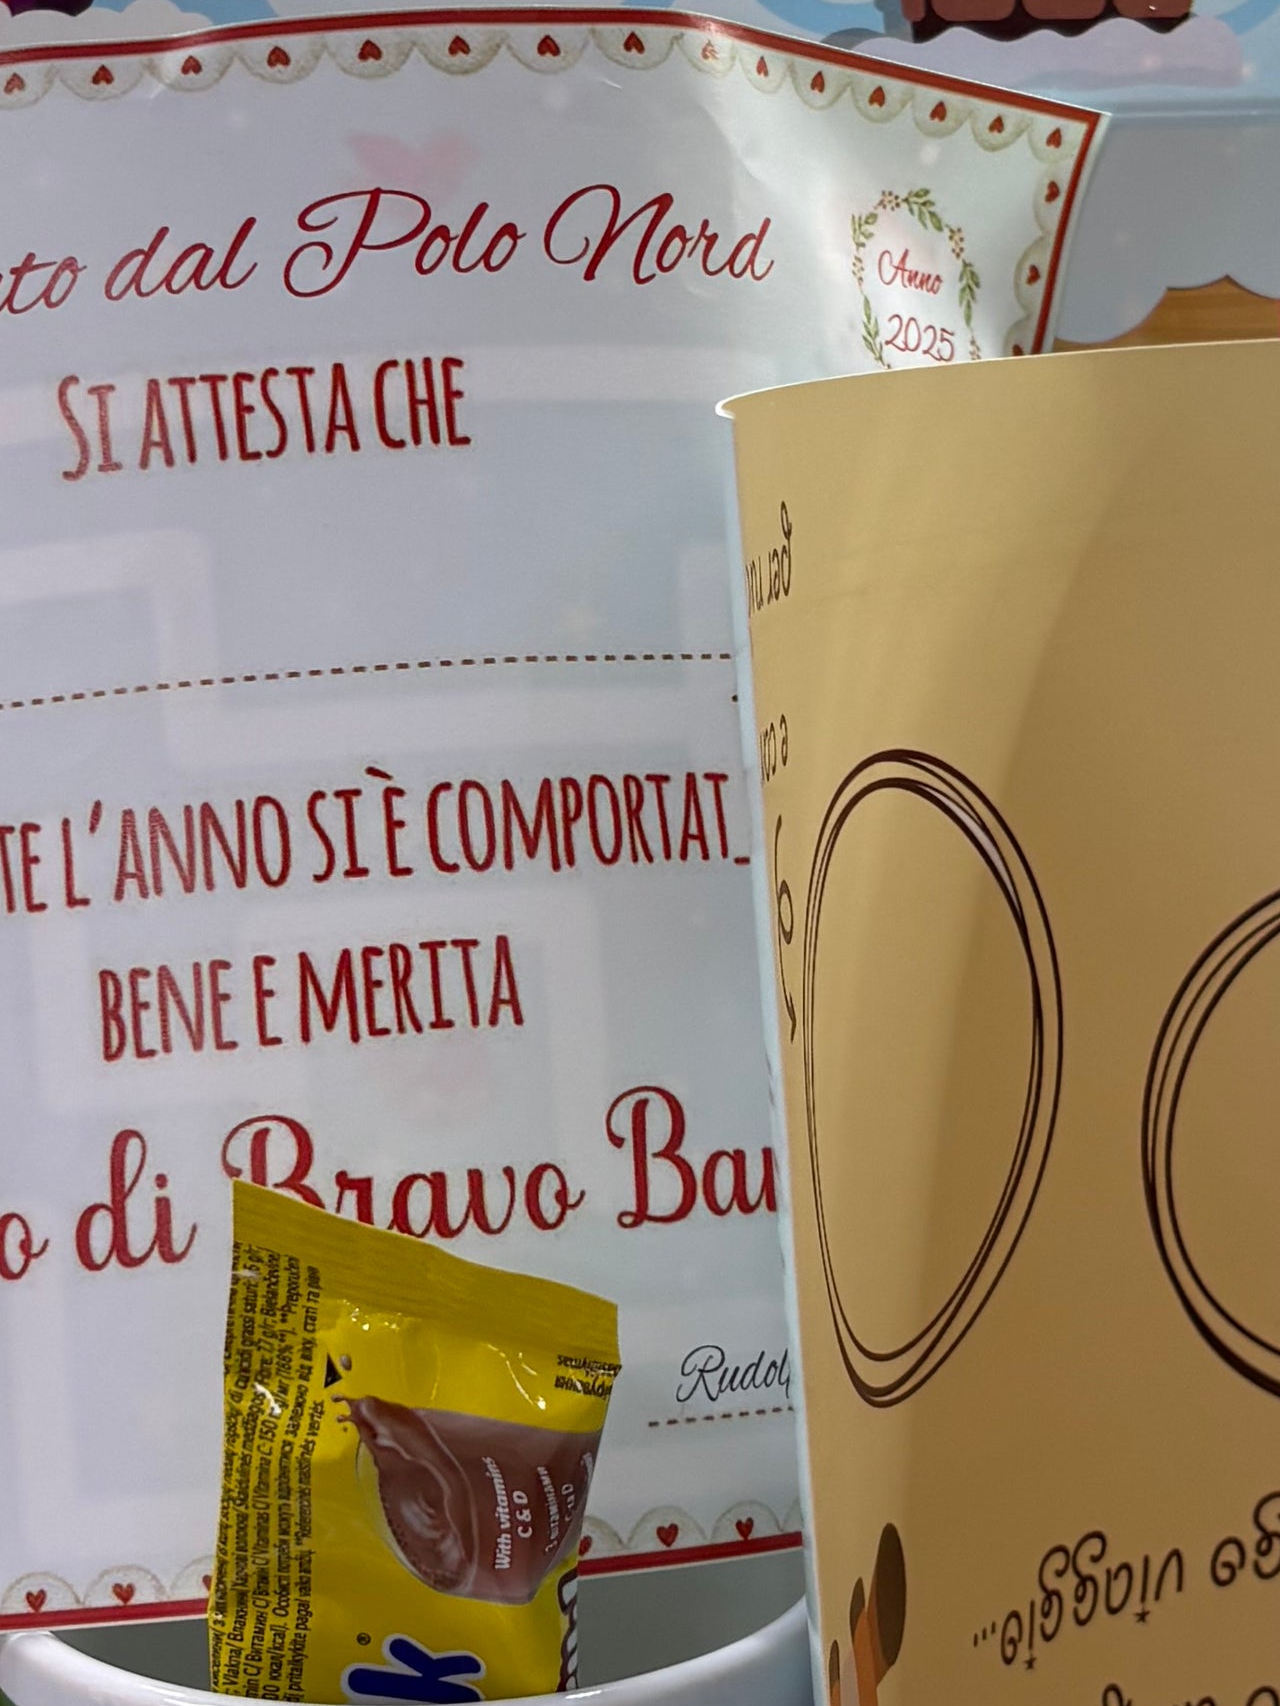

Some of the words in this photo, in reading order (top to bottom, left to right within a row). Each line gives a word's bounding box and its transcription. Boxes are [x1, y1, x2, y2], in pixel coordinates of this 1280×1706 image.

[104, 216, 258, 301] dal
[284, 186, 527, 298] Polo
[544, 183, 775, 285] Nord
[877, 248, 944, 296] Anno
[884, 314, 956, 363] 2025
[140, 362, 362, 471] ATTESTA
[372, 355, 472, 449] CHE
[307, 788, 370, 883] SI
[365, 765, 415, 878] È
[98, 958, 239, 1063] BENE
[252, 954, 284, 1048] E
[298, 934, 525, 1045] MERITA
[75, 1128, 198, 1272] di
[221, 1114, 587, 1241] Bravo
[676, 1345, 790, 1404] Rudol
[260, 1420, 280, 1443] 150
[481, 1456, 512, 1530] vitamins
[512, 1490, 528, 1505] D
[515, 1508, 532, 1523] &
[493, 1534, 511, 1570] With
[517, 1525, 532, 1539] C
[293, 1597, 314, 1631] pagal
